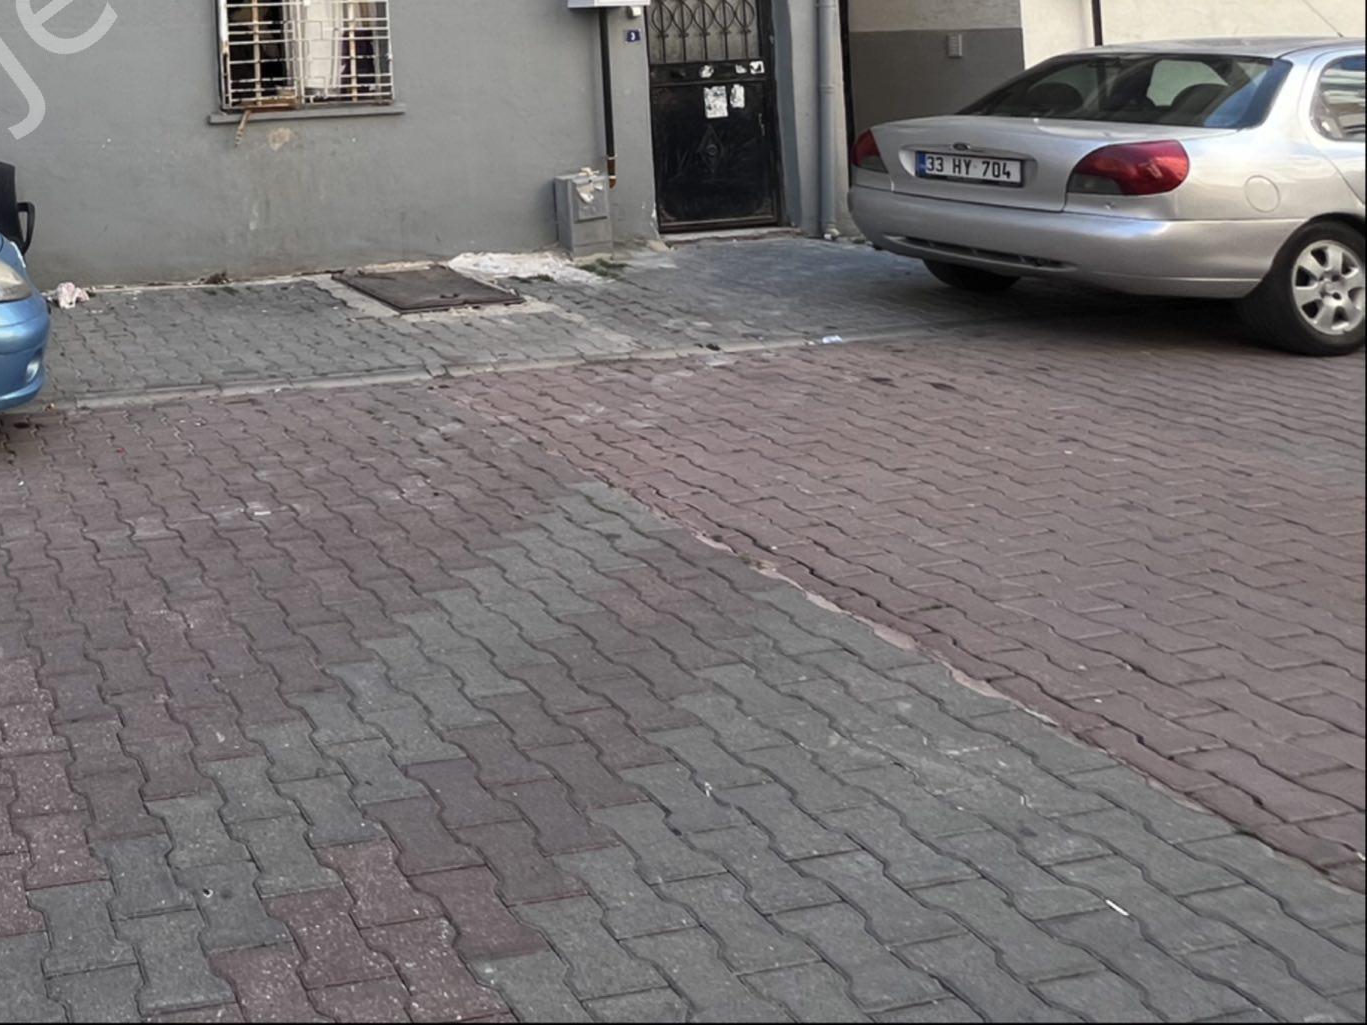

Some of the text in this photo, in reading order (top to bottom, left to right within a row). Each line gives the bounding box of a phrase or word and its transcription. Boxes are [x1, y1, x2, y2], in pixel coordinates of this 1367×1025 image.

[926, 156, 1011, 180] 33 HY 704
